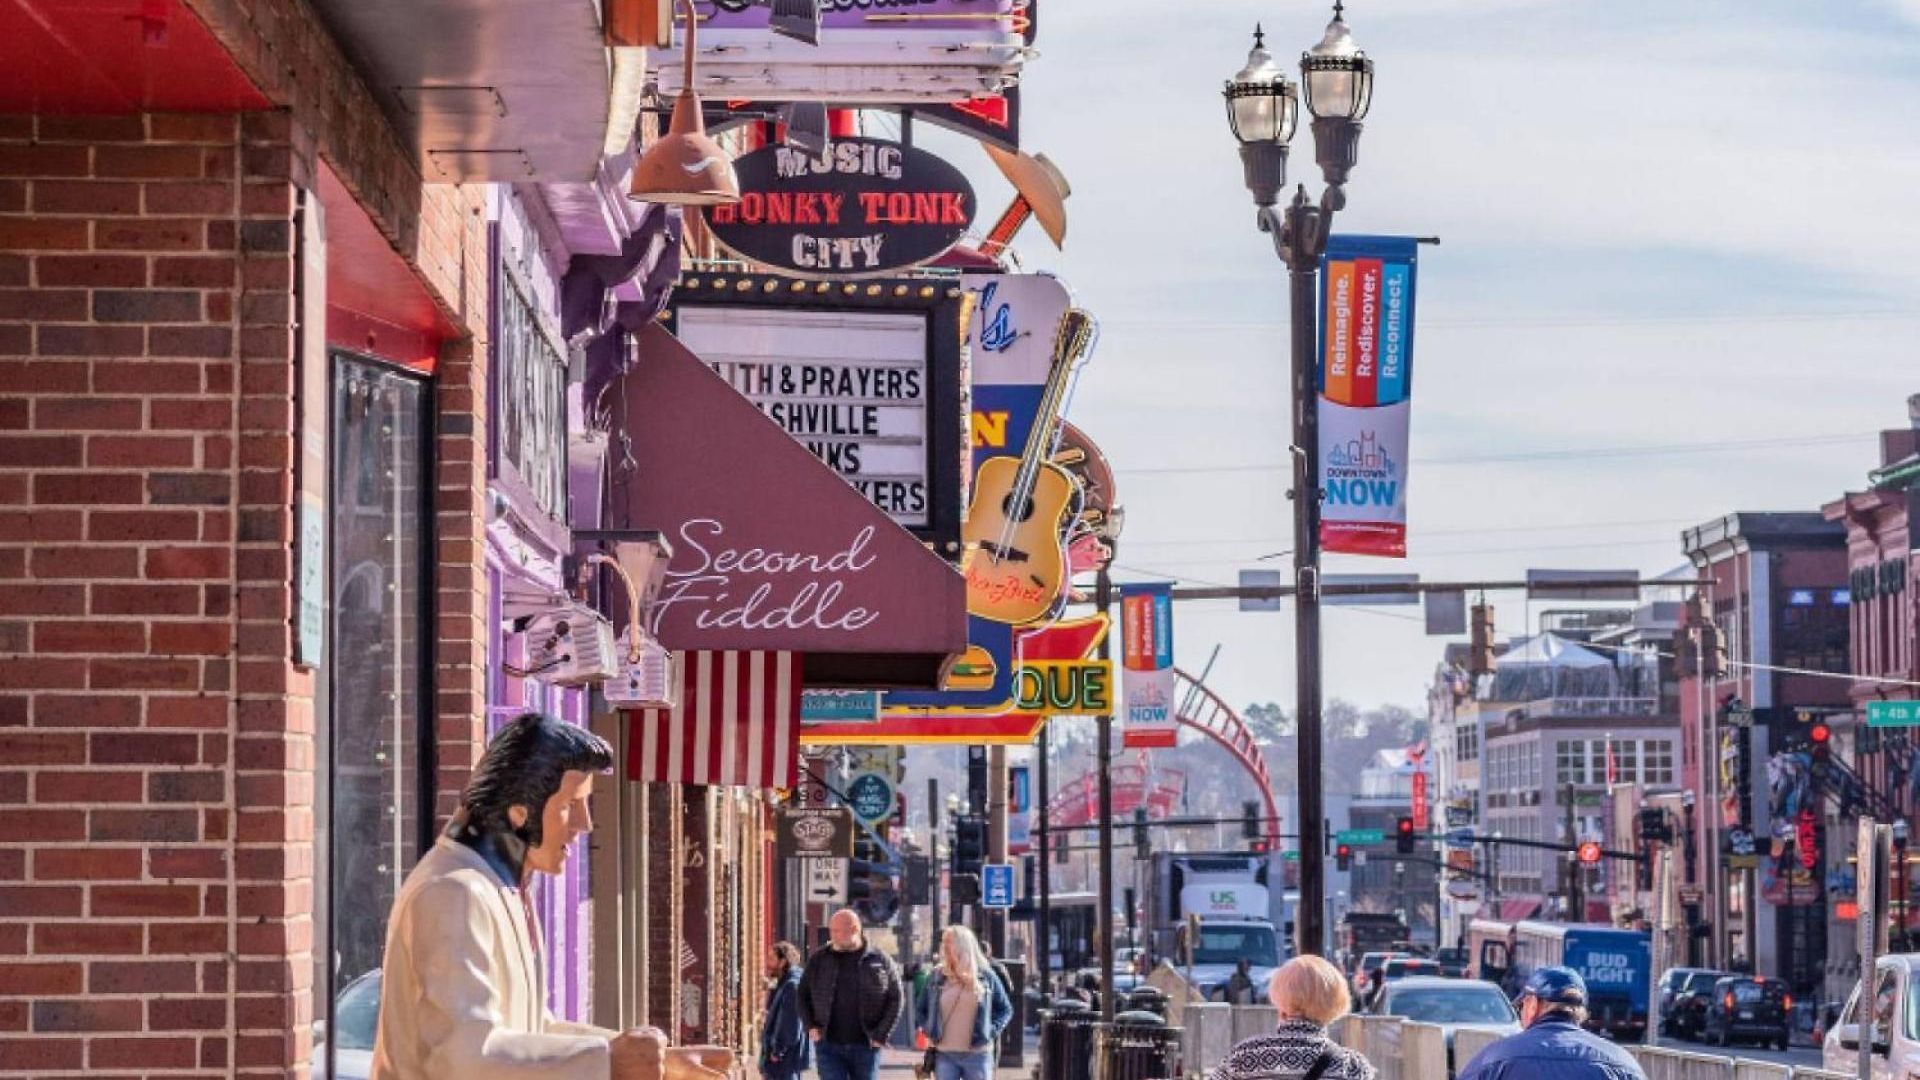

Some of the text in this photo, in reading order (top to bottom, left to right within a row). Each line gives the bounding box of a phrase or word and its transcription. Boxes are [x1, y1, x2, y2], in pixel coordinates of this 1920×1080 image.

[776, 142, 902, 179] MUSIC
[711, 192, 969, 224] HONKY TONK
[791, 233, 885, 268] CITY
[1331, 273, 1350, 377] Reimagine.
[1356, 267, 1376, 377] Rediscover.
[1382, 272, 1403, 379] Reconnect.
[801, 366, 920, 399] PRAYERS
[756, 402, 879, 435] SHVILLE
[1326, 466, 1388, 478] DOWNTOWN
[1326, 479, 1397, 506] NOW
[666, 519, 877, 576] Second
[653, 575, 880, 635] Fiddle
[1012, 666, 1107, 709] QUE
[1129, 708, 1168, 721] NOW
[1210, 891, 1236, 903] US
[1580, 966, 1636, 983] LIGHT
[1587, 952, 1628, 968] BUD
